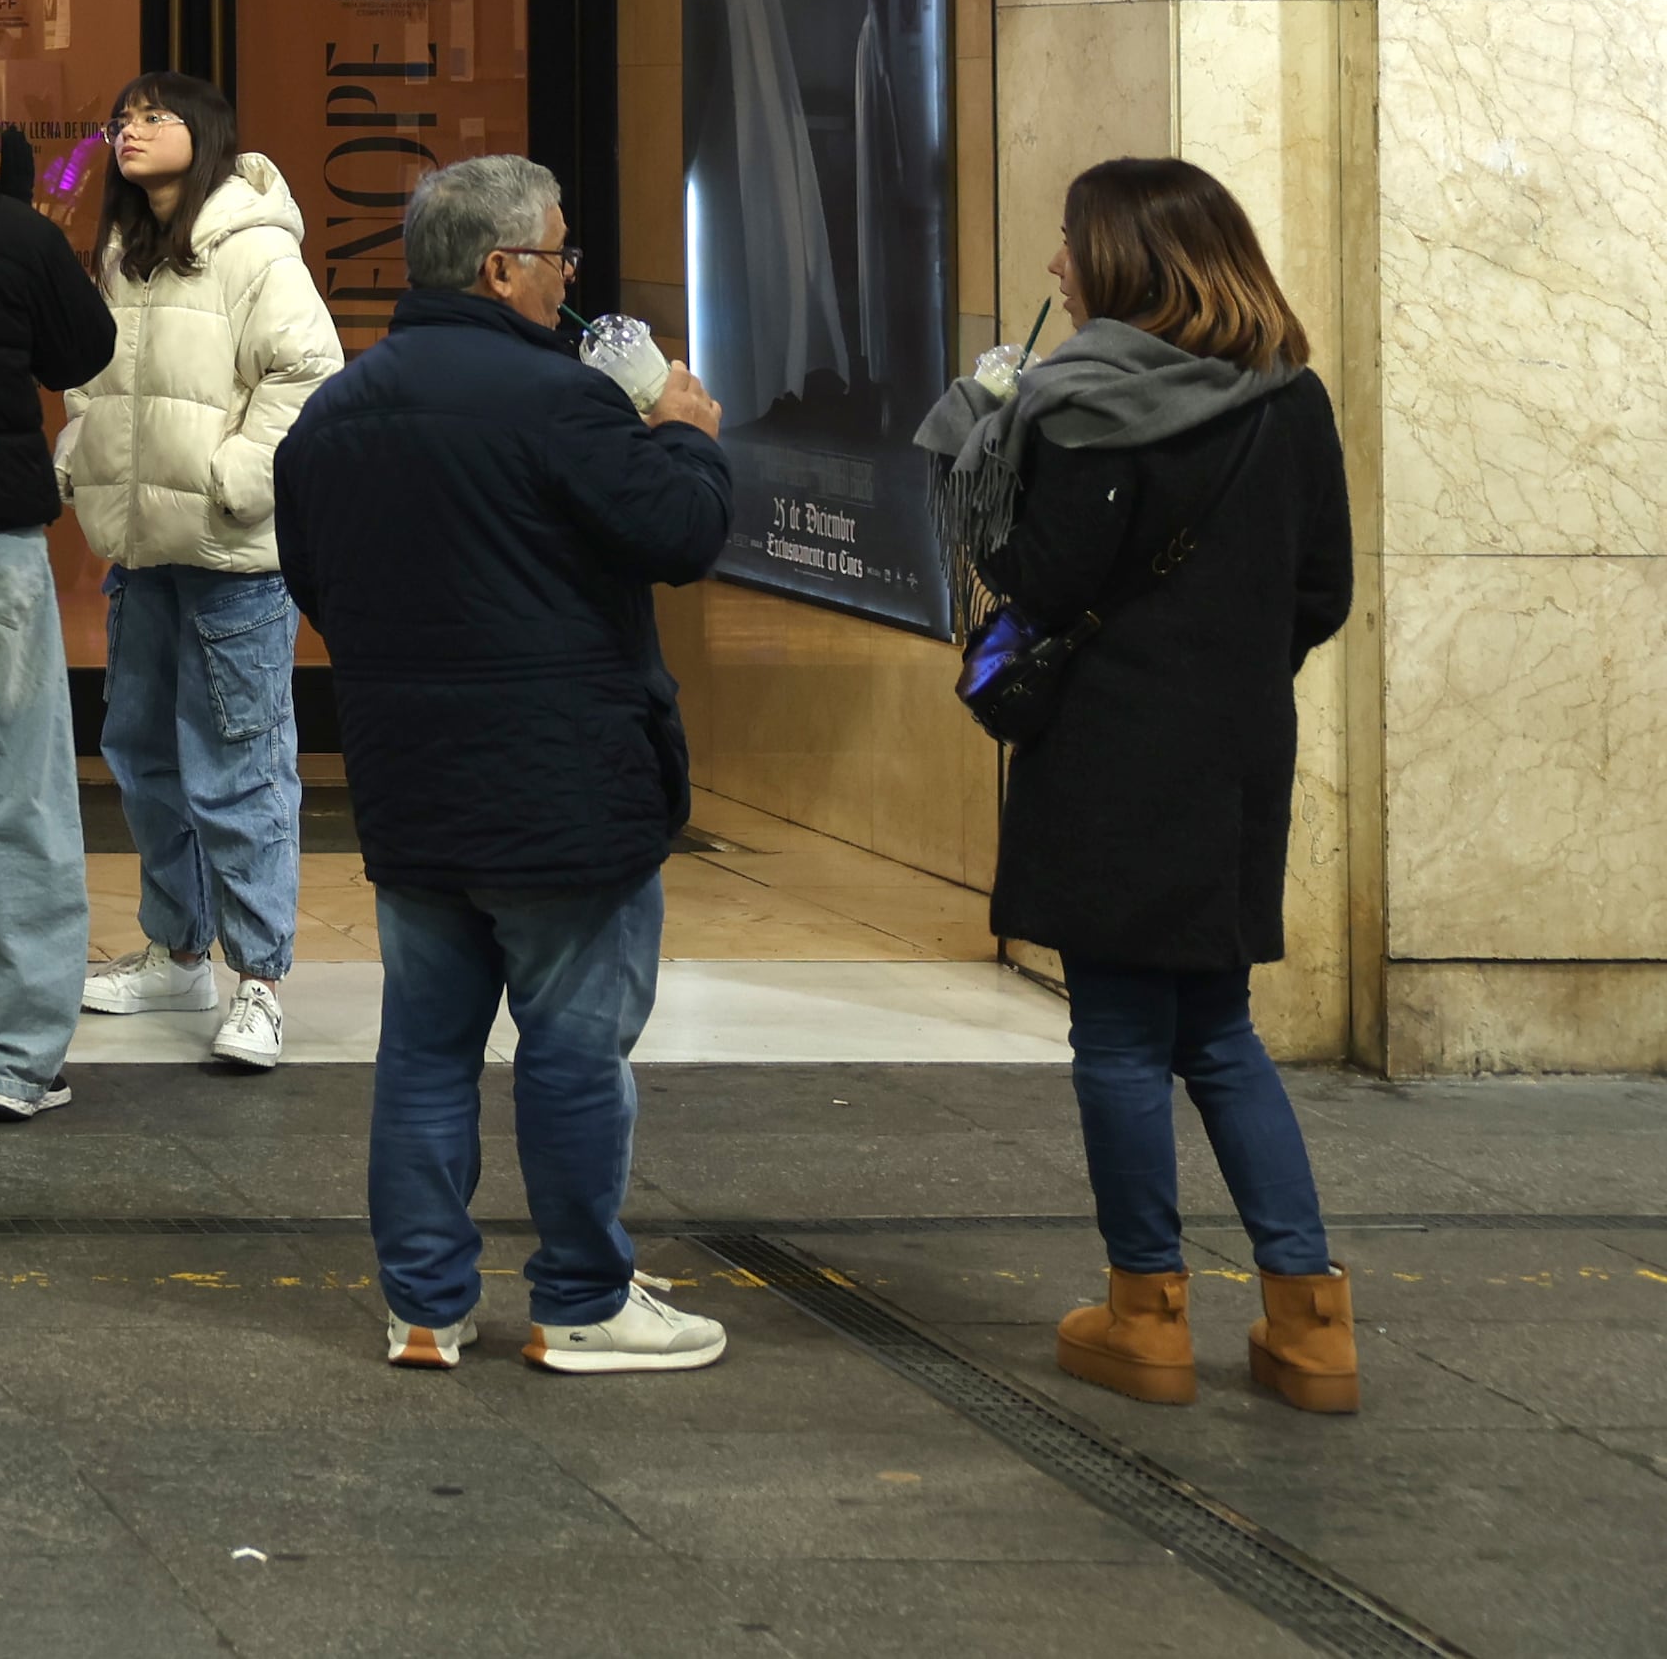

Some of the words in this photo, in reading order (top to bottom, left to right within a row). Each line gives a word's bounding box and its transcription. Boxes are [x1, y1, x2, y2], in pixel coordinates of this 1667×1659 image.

[29, 121, 62, 139] LLENA
[63, 121, 78, 139] DE
[789, 498, 801, 531] de
[804, 502, 856, 544] Diciembre
